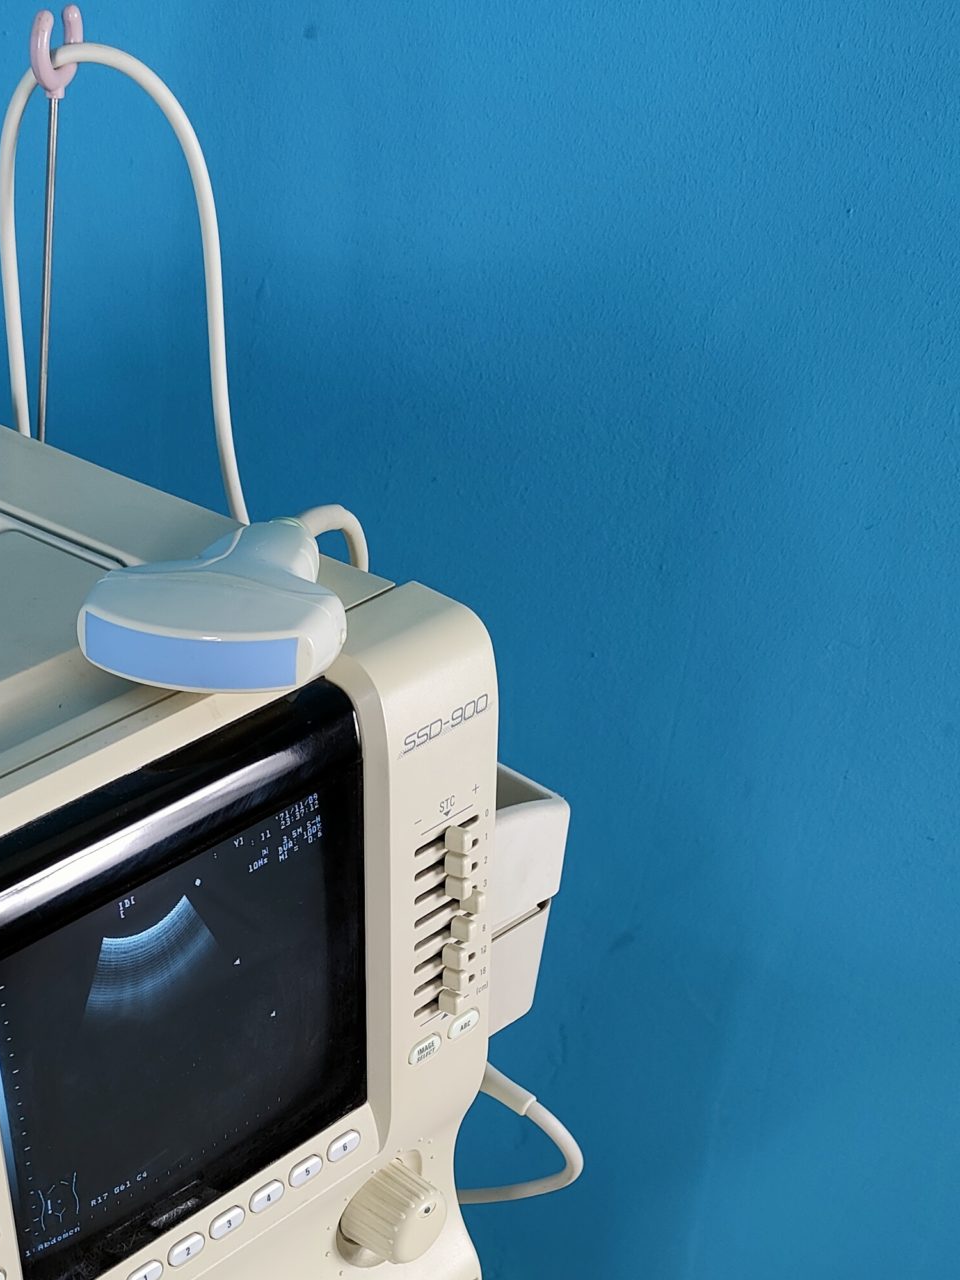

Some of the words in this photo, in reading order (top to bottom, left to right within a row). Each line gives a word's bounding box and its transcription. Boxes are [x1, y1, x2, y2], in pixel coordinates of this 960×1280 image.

[403, 693, 489, 755] SSD-900
[439, 795, 456, 813] STC
[417, 1040, 435, 1056] IMAGE
